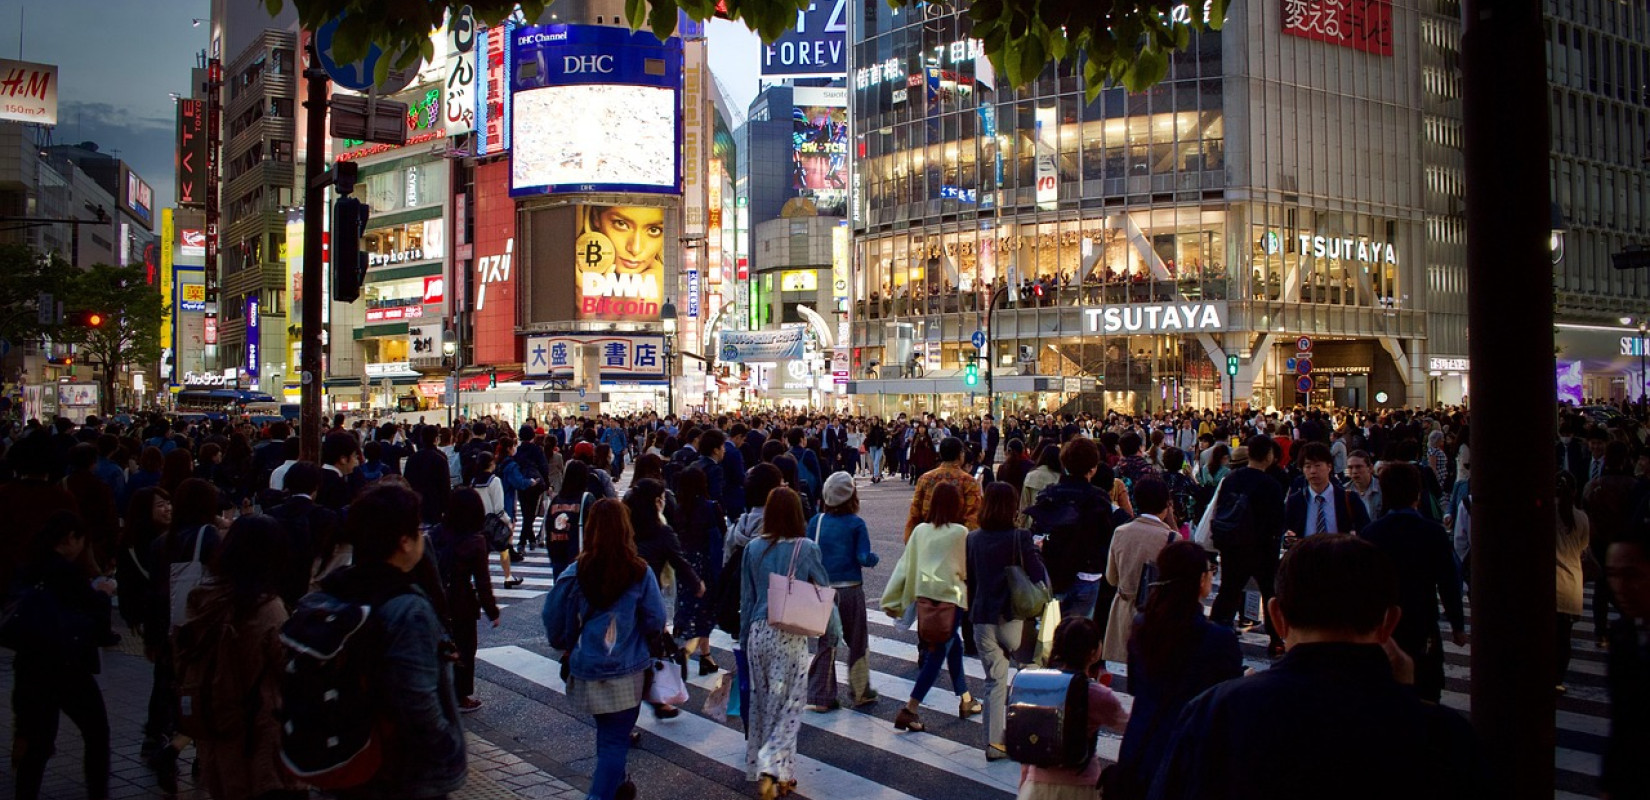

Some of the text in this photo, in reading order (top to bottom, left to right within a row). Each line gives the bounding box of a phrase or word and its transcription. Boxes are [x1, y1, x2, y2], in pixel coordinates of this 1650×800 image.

[534, 31, 567, 43] Channel
[563, 55, 613, 74] DHC
[1, 68, 50, 101] H&M
[1299, 234, 1397, 265] TSUTAYA
[582, 271, 658, 298] DMM
[582, 297, 658, 315] Bitcoin
[1085, 304, 1221, 331] TSUTAYA
